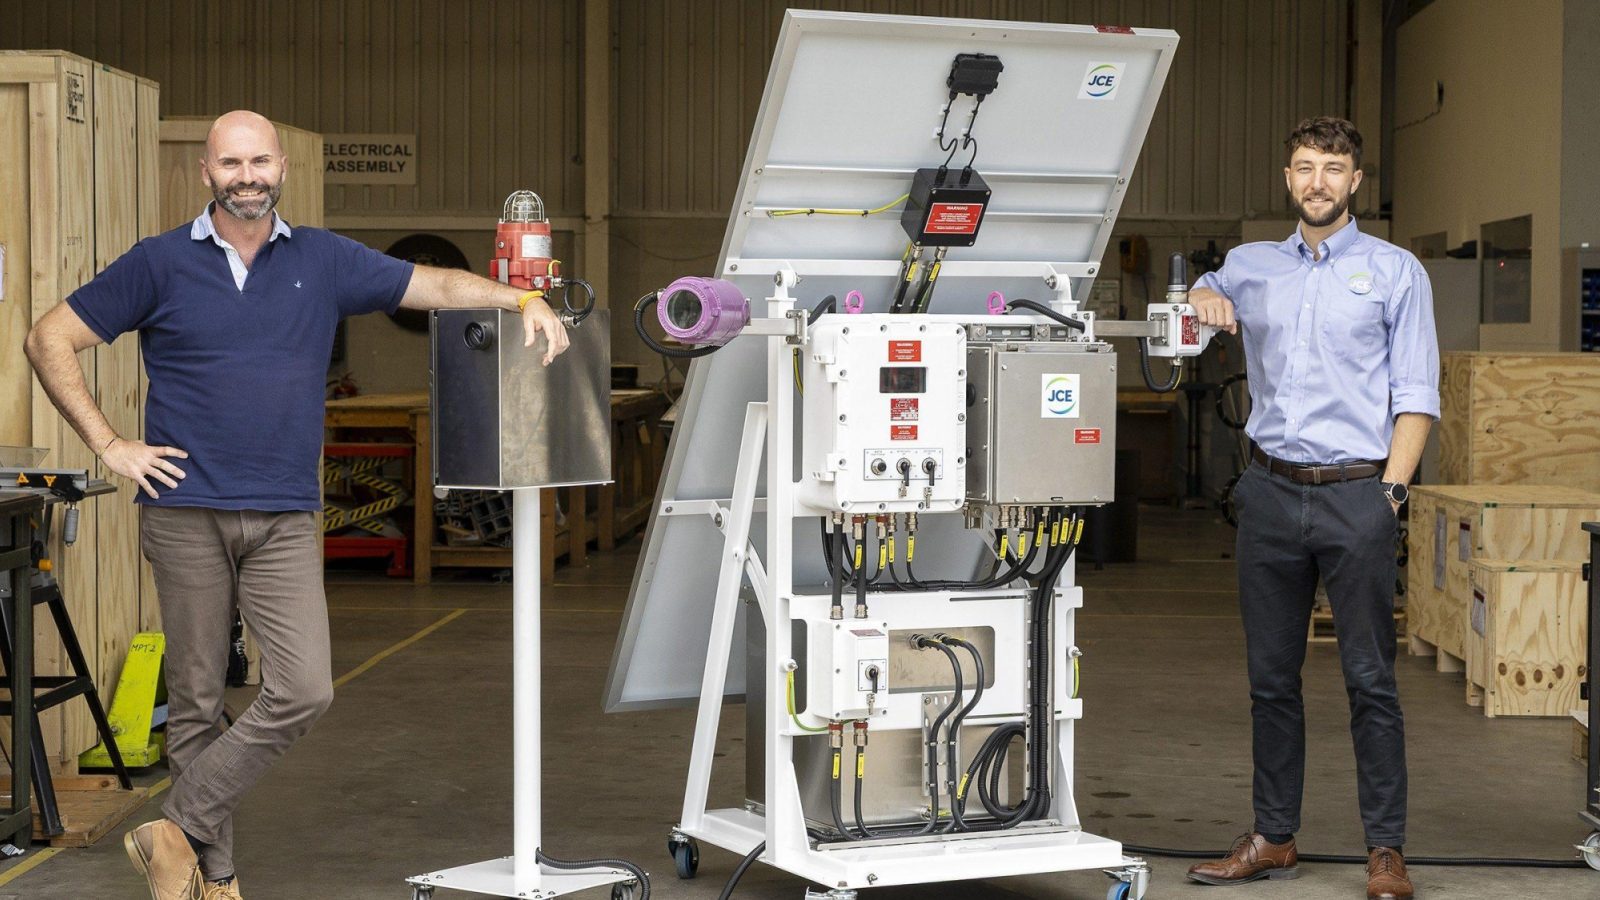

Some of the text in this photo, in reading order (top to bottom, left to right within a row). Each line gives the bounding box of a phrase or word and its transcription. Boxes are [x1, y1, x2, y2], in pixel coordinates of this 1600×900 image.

[1088, 75, 1115, 86] JCE
[323, 143, 412, 156] ELECTRICAL
[326, 160, 406, 173] ASSEMBLY
[1351, 279, 1371, 290] JCE
[1047, 389, 1073, 402] JCE
